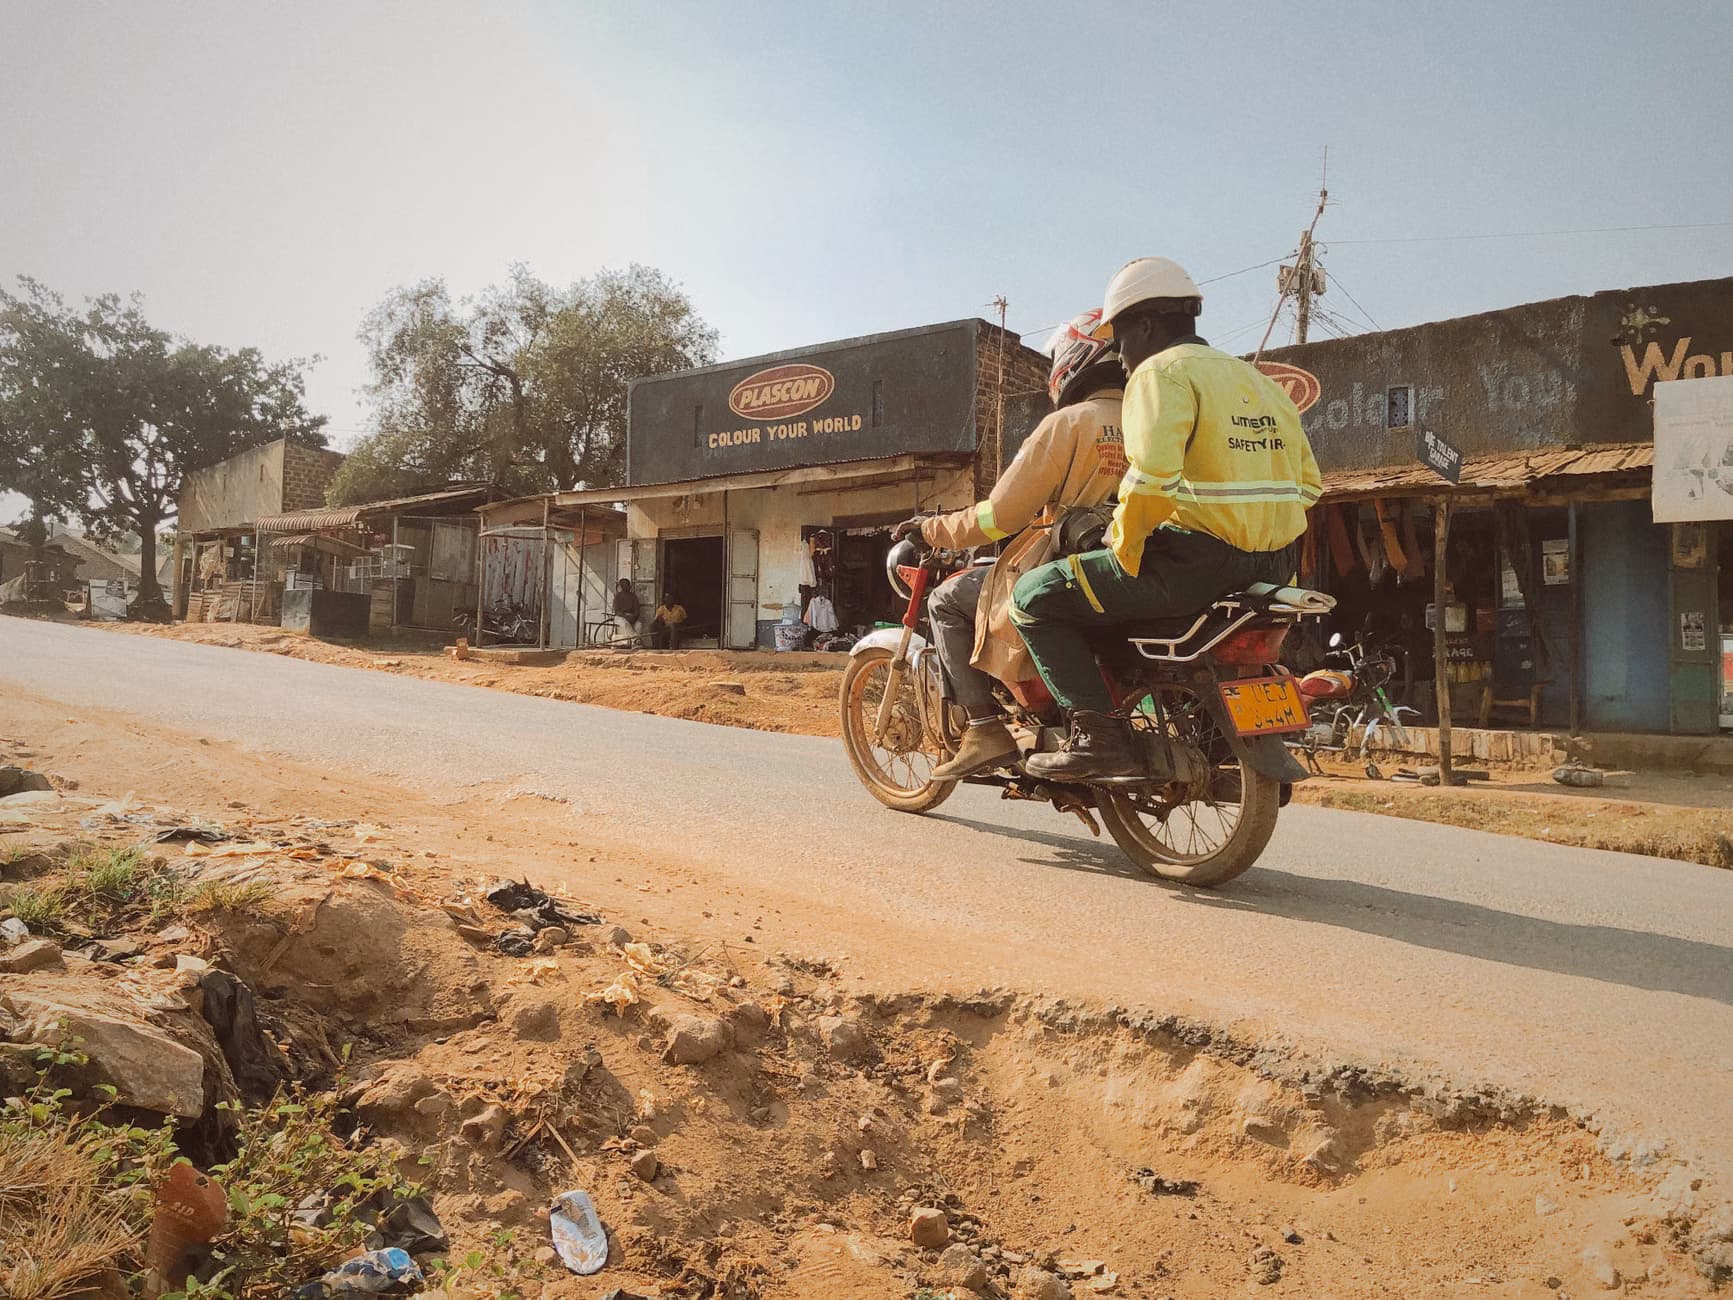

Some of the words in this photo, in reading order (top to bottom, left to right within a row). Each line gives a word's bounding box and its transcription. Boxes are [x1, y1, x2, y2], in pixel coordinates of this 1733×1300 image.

[739, 378, 821, 409] PLASCON
[708, 428, 761, 449] COLOUR
[767, 422, 808, 441] YOUR
[813, 415, 862, 434] WORLD
[1228, 437, 1267, 452] SAFETY
